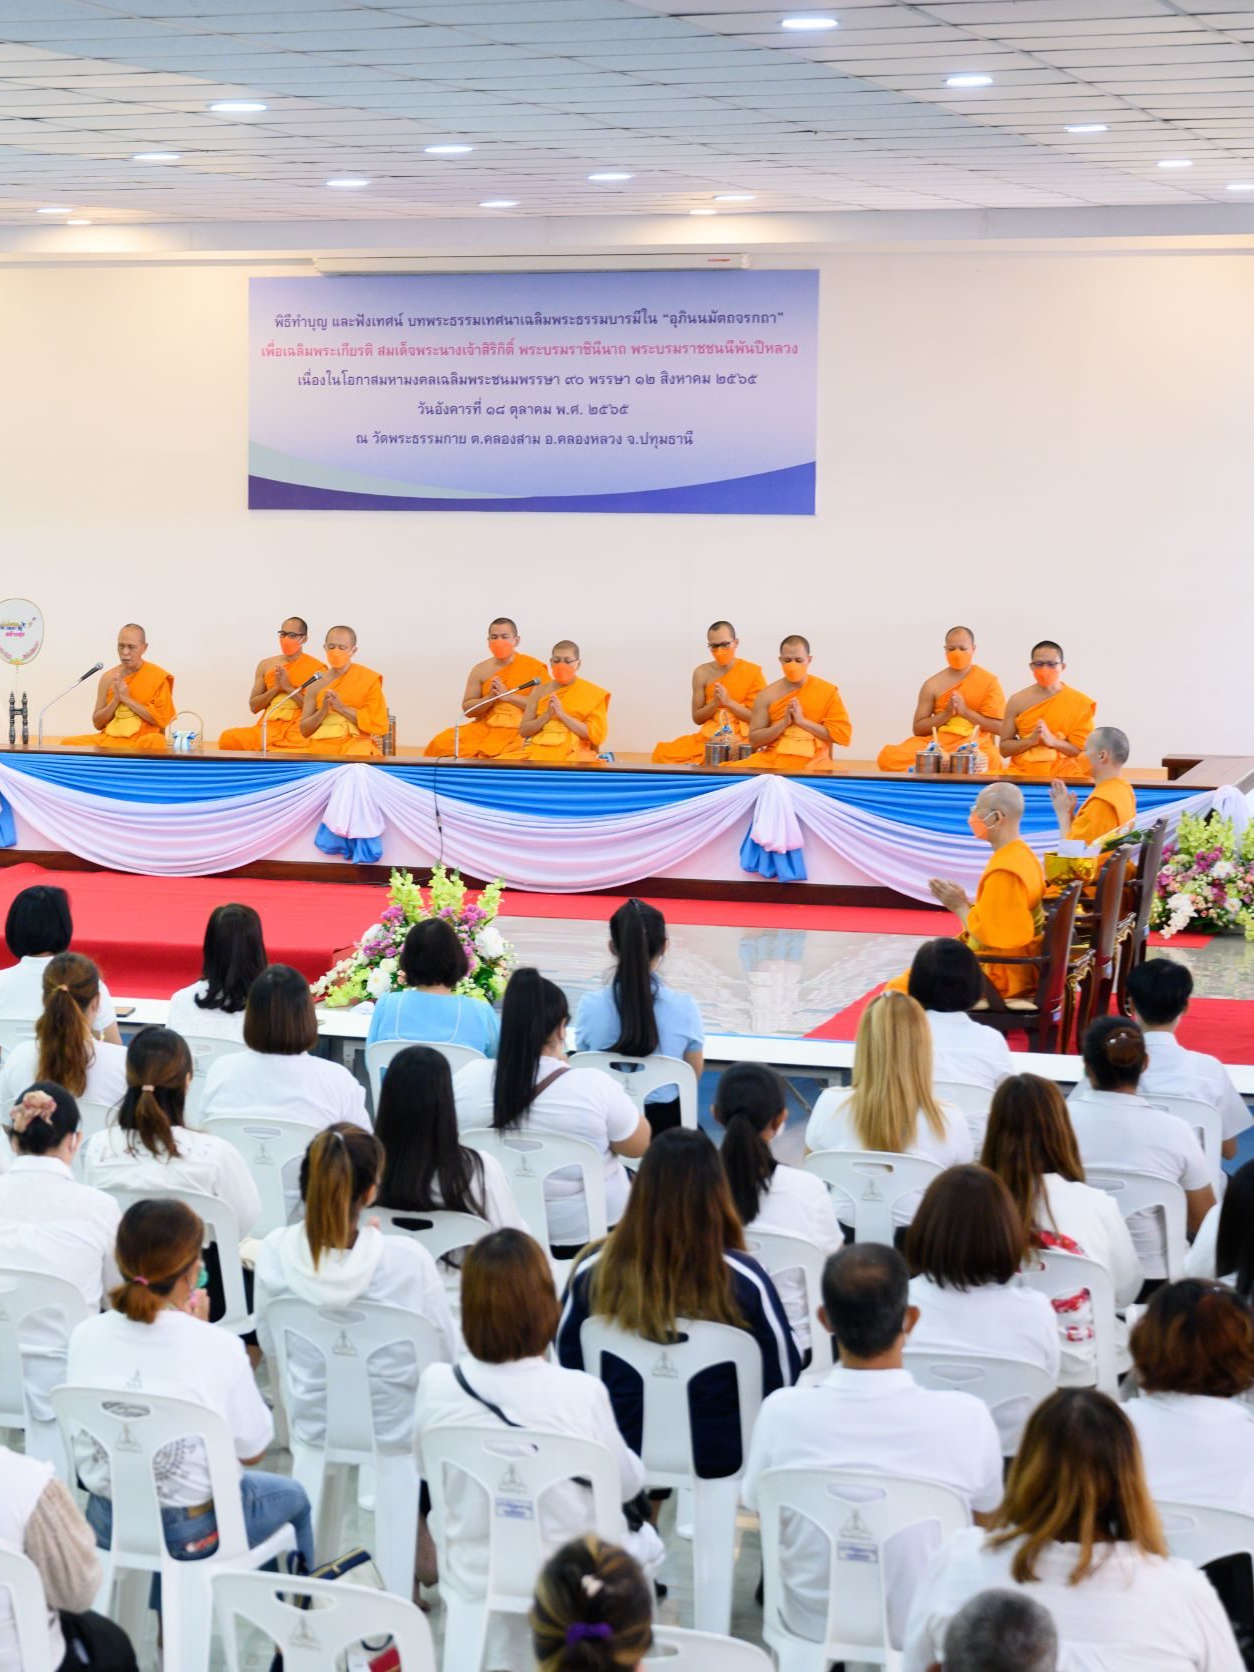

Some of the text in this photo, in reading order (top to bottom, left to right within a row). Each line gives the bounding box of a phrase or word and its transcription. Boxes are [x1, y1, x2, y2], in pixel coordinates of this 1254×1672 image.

[274, 313, 328, 332] พิธีทำบุญ
[331, 312, 405, 328] และฟังเทศน์
[260, 337, 799, 358] เพื่อเฉลิมพระเกียรติ สมเด็จพระนางเจ้าสิริกิติ์ พระบรมราชินีนาถ พระบรมราชชนนีพันปีหลวง
[564, 374, 585, 386] ๙๐
[587, 374, 631, 385] พรรษา
[634, 373, 656, 386] ๑๒
[659, 370, 712, 385] สิงหาคม
[715, 372, 759, 385] ๒๕๖๕
[417, 396, 630, 420] วันอังคารที่ ๑๘ ตุลาคม พ.ศ. ๒๕๖๕
[355, 429, 694, 450] ณ วัดพระธรรมกาย ต.คลองสาม อ.คลองหลวง จ.ปทุมธานี
